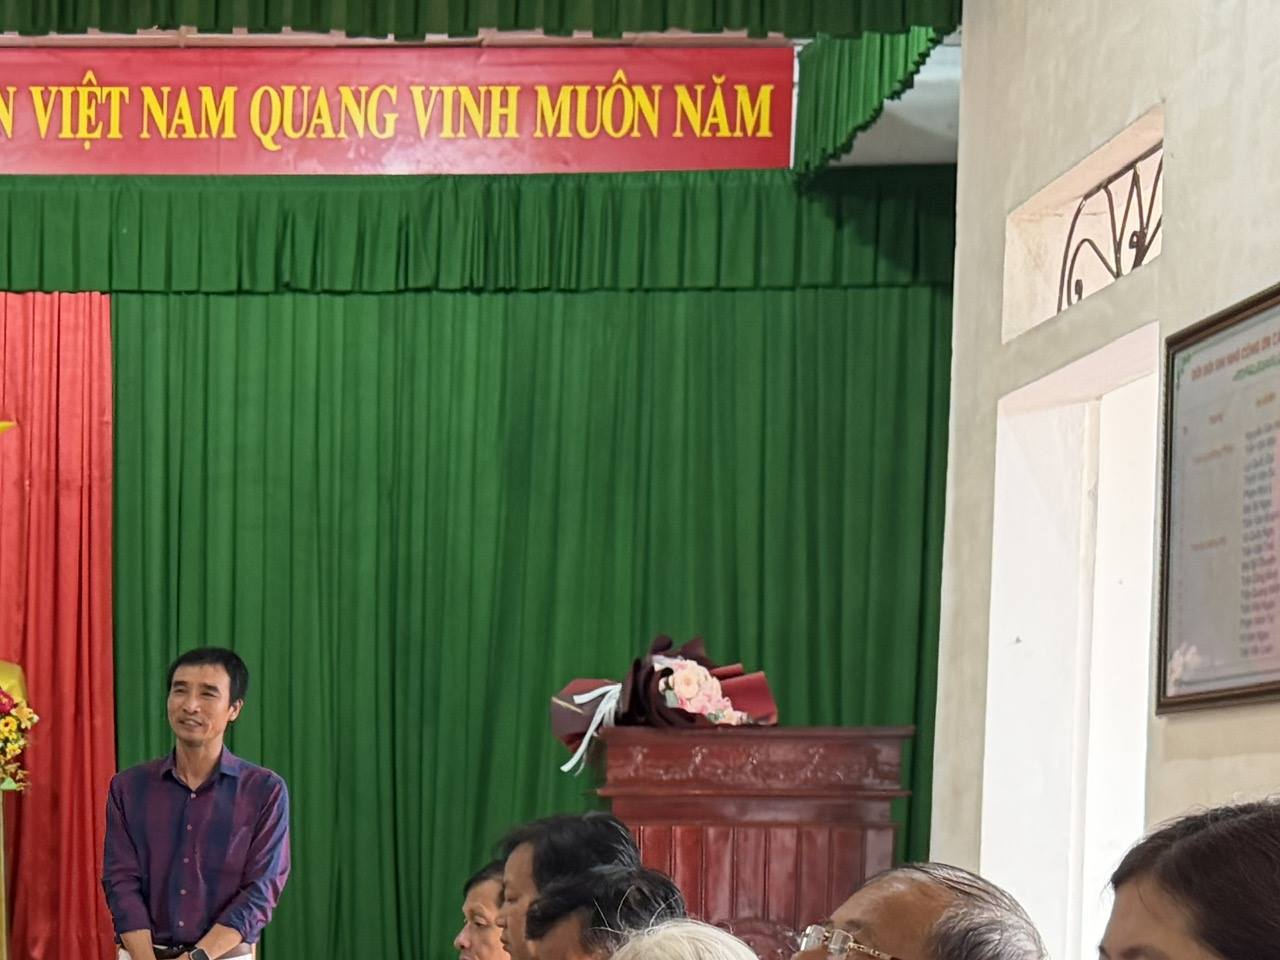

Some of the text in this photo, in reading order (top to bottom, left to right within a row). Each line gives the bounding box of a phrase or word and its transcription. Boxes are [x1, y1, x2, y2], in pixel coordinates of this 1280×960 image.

[30, 70, 129, 150] VIỆT
[140, 85, 237, 139] NAM
[250, 84, 398, 151] QUANG
[410, 84, 520, 139] VINH
[533, 68, 662, 139] MUÔN
[672, 74, 774, 139] NĂM
